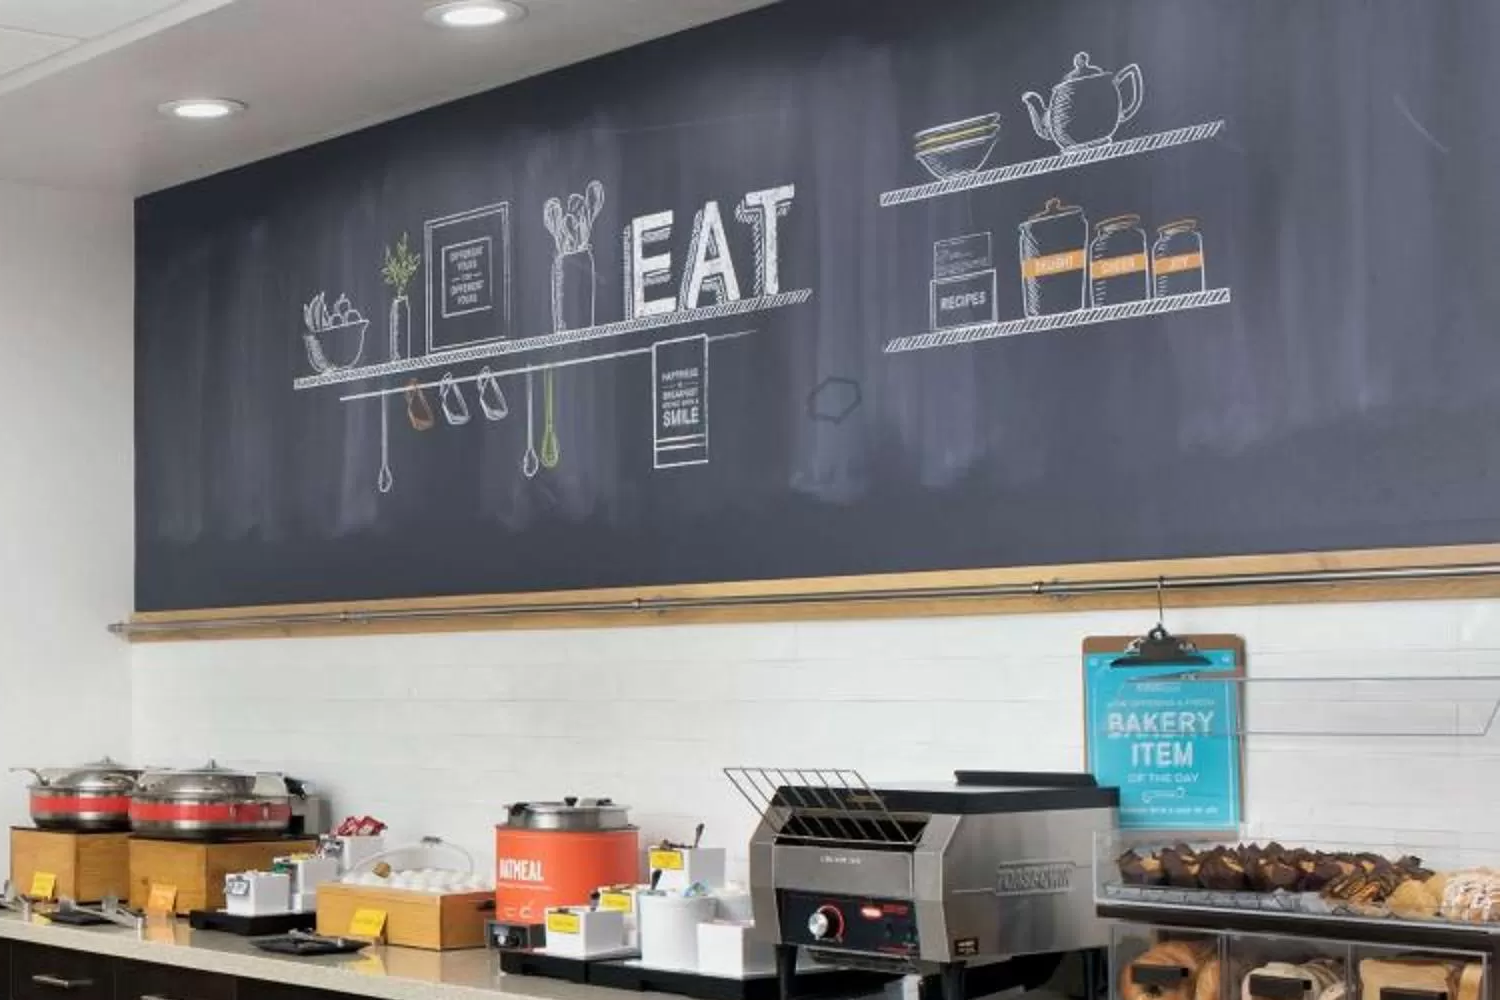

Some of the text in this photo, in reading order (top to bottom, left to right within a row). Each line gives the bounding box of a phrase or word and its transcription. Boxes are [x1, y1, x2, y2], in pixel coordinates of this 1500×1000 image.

[623, 184, 794, 320] EAT
[940, 291, 986, 311] RECIPES
[663, 405, 700, 428] SMILE
[1107, 711, 1215, 738] BAKERY
[1131, 741, 1194, 769] ITEM
[1175, 772, 1200, 783] DAY
[499, 857, 545, 881] OATMEAL
